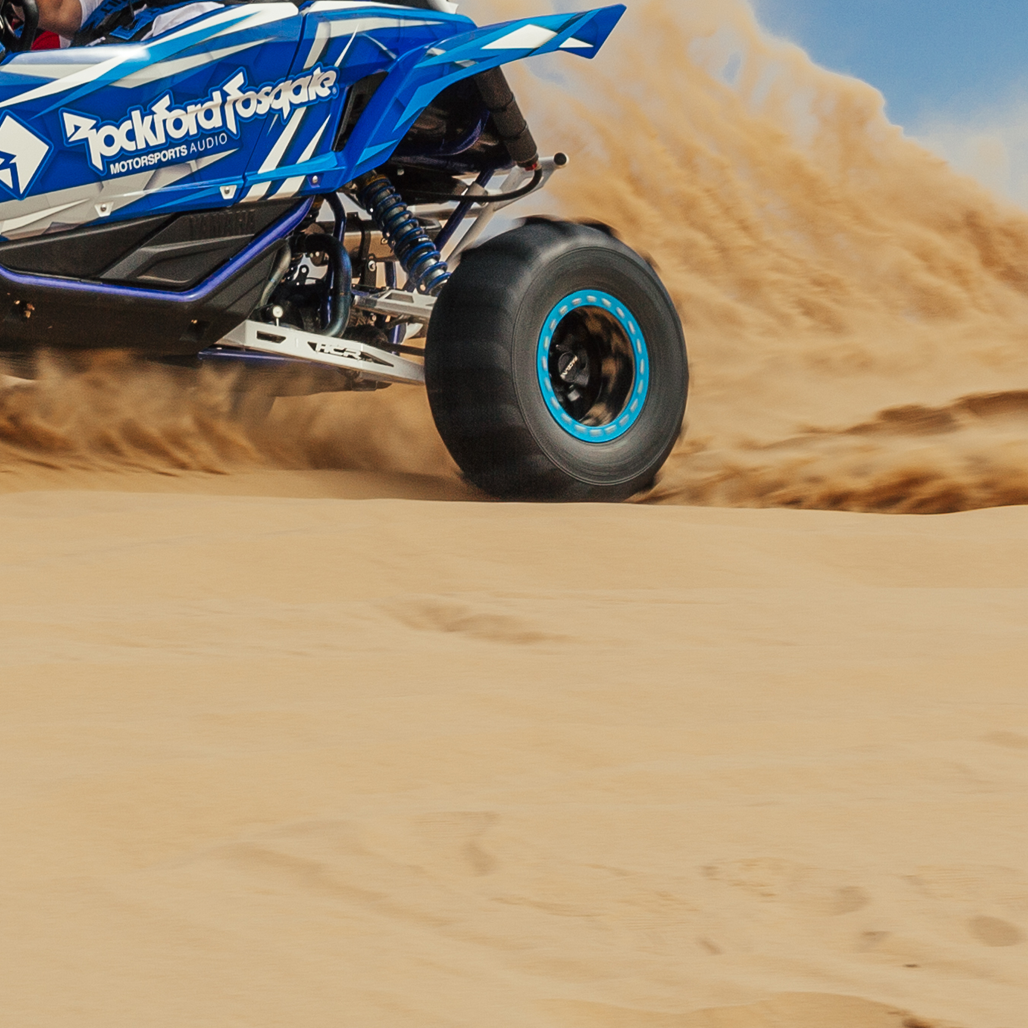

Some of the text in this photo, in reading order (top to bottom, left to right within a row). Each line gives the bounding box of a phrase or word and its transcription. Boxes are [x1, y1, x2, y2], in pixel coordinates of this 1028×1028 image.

[62, 67, 337, 171] Rockford Fosgate
[110, 132, 228, 175] MOTORSPORTS AUDIO
